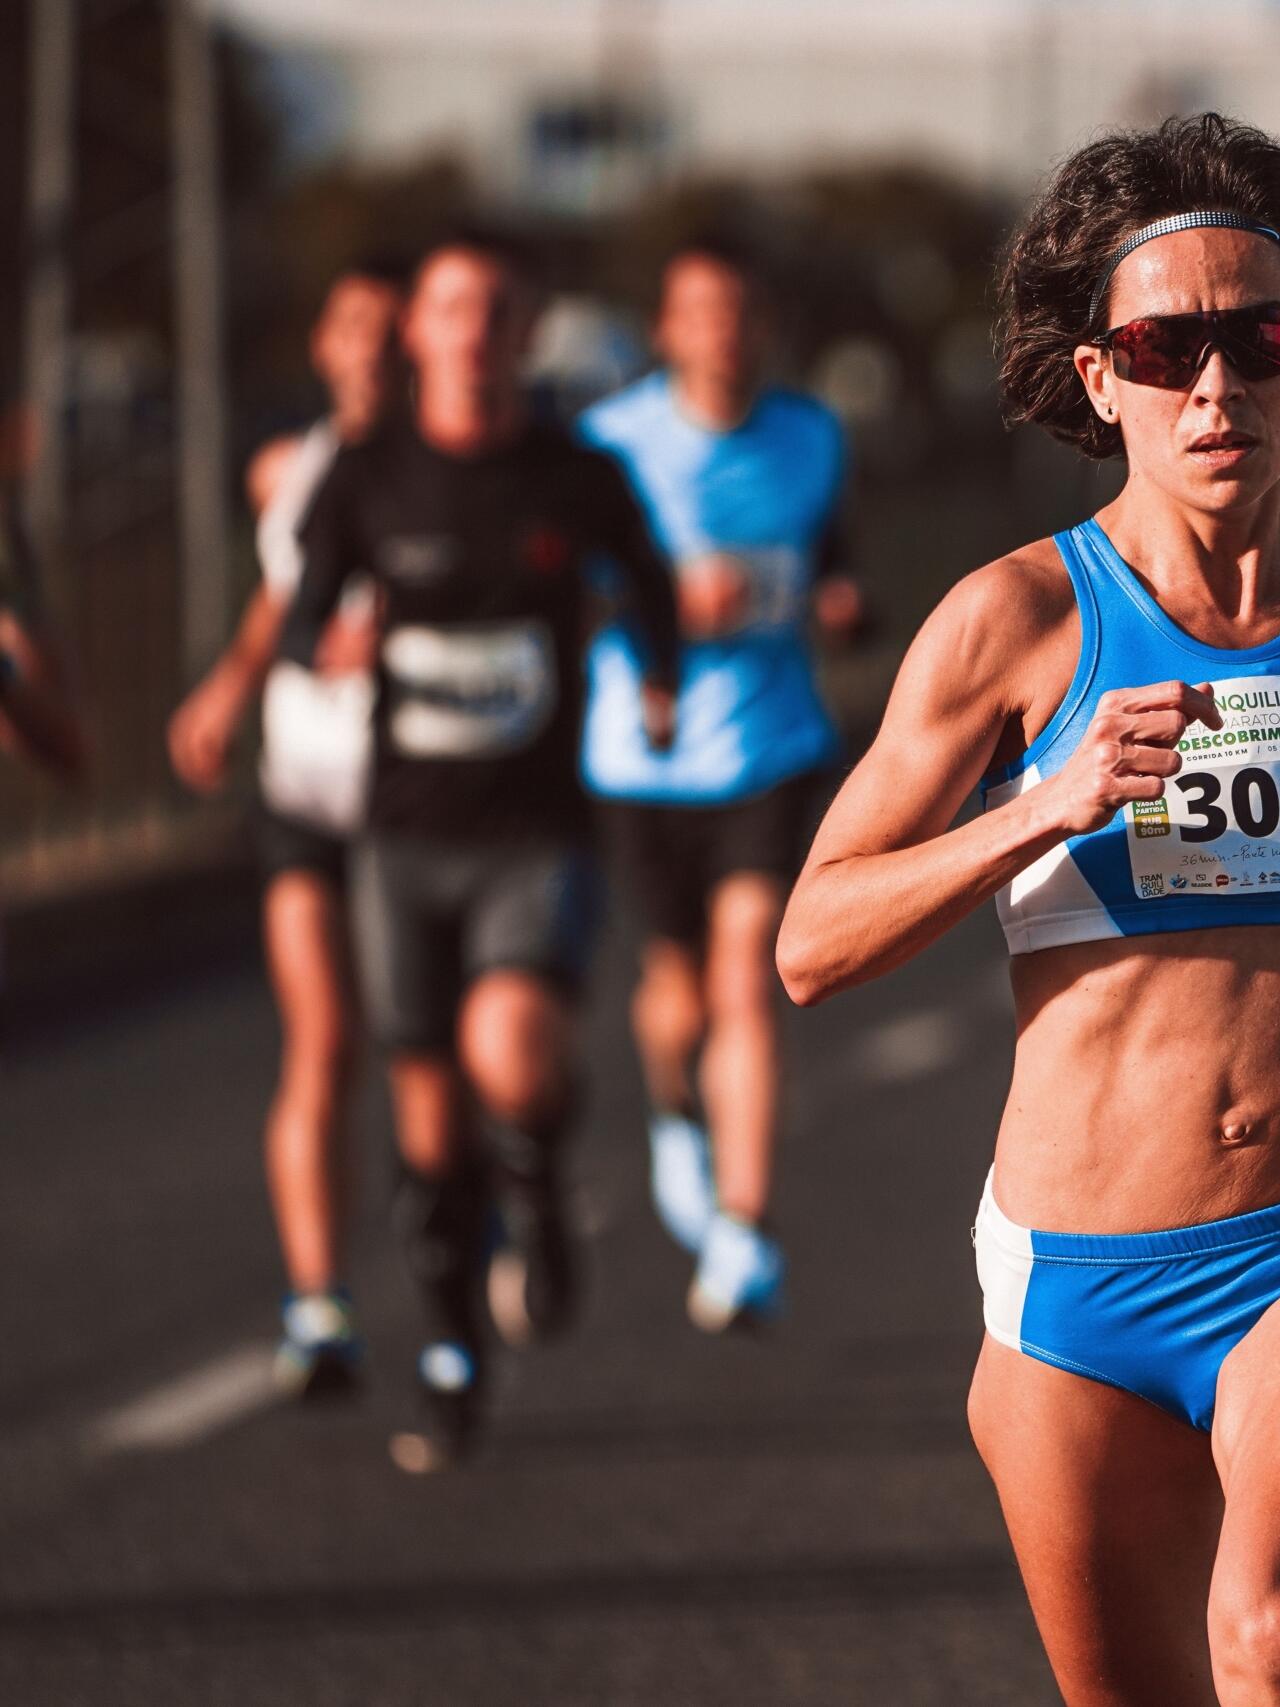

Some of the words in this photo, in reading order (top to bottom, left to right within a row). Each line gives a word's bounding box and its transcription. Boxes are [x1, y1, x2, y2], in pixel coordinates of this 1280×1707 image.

[1186, 752, 1223, 762] CORRIDA
[1225, 750, 1233, 758] 10
[1235, 748, 1248, 756] KM
[1135, 806, 1166, 815] PARTIDA
[1141, 816, 1162, 826] SUB
[1141, 826, 1165, 836] 90m
[1139, 873, 1163, 883] TRAN
[1142, 888, 1165, 897] DADE
